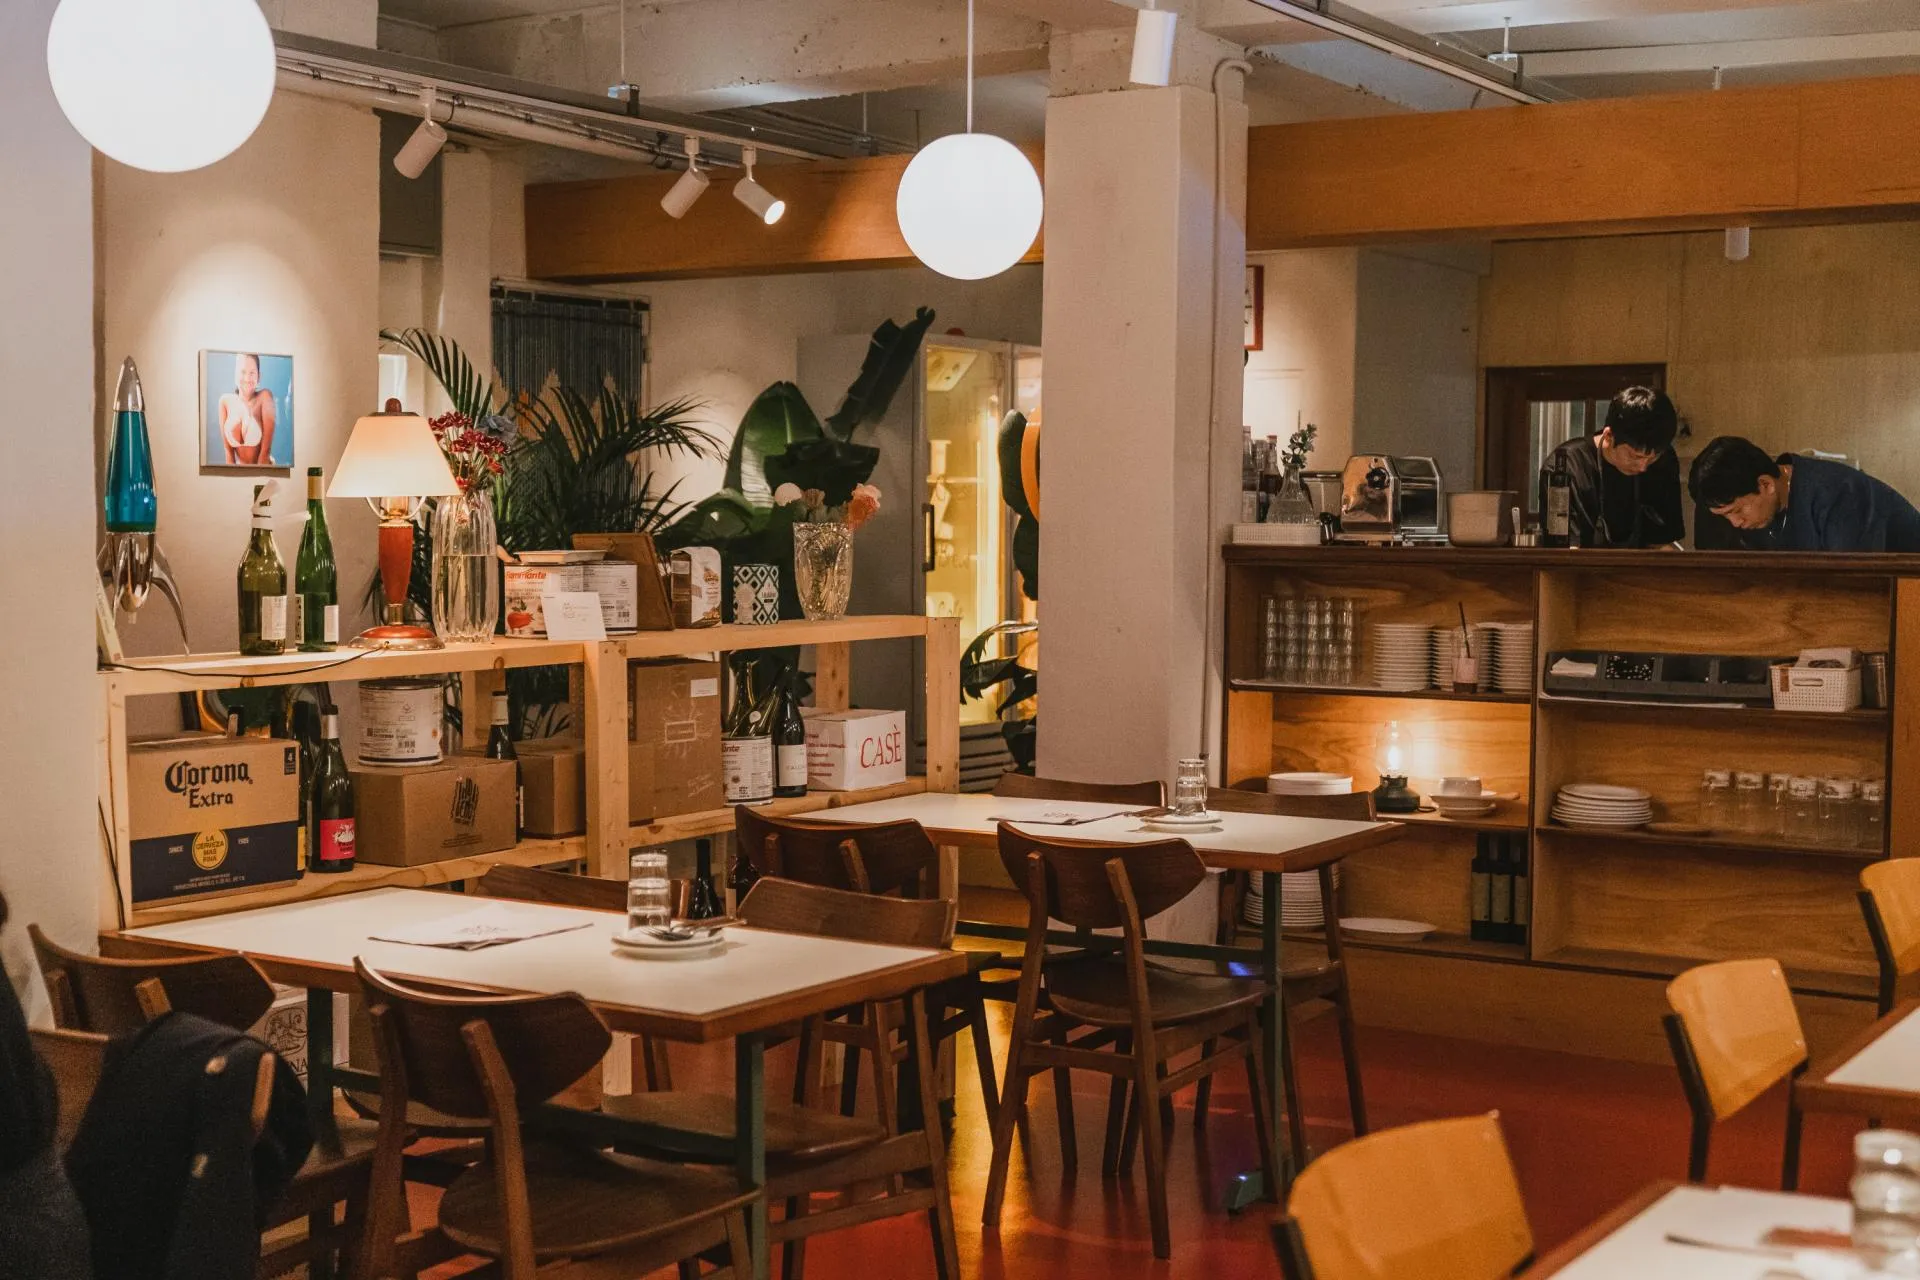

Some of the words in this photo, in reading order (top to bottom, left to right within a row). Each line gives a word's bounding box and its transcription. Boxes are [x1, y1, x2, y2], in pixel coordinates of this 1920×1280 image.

[860, 723, 902, 768] CASÈ
[165, 760, 250, 796] Corona
[189, 788, 233, 808] Extra
